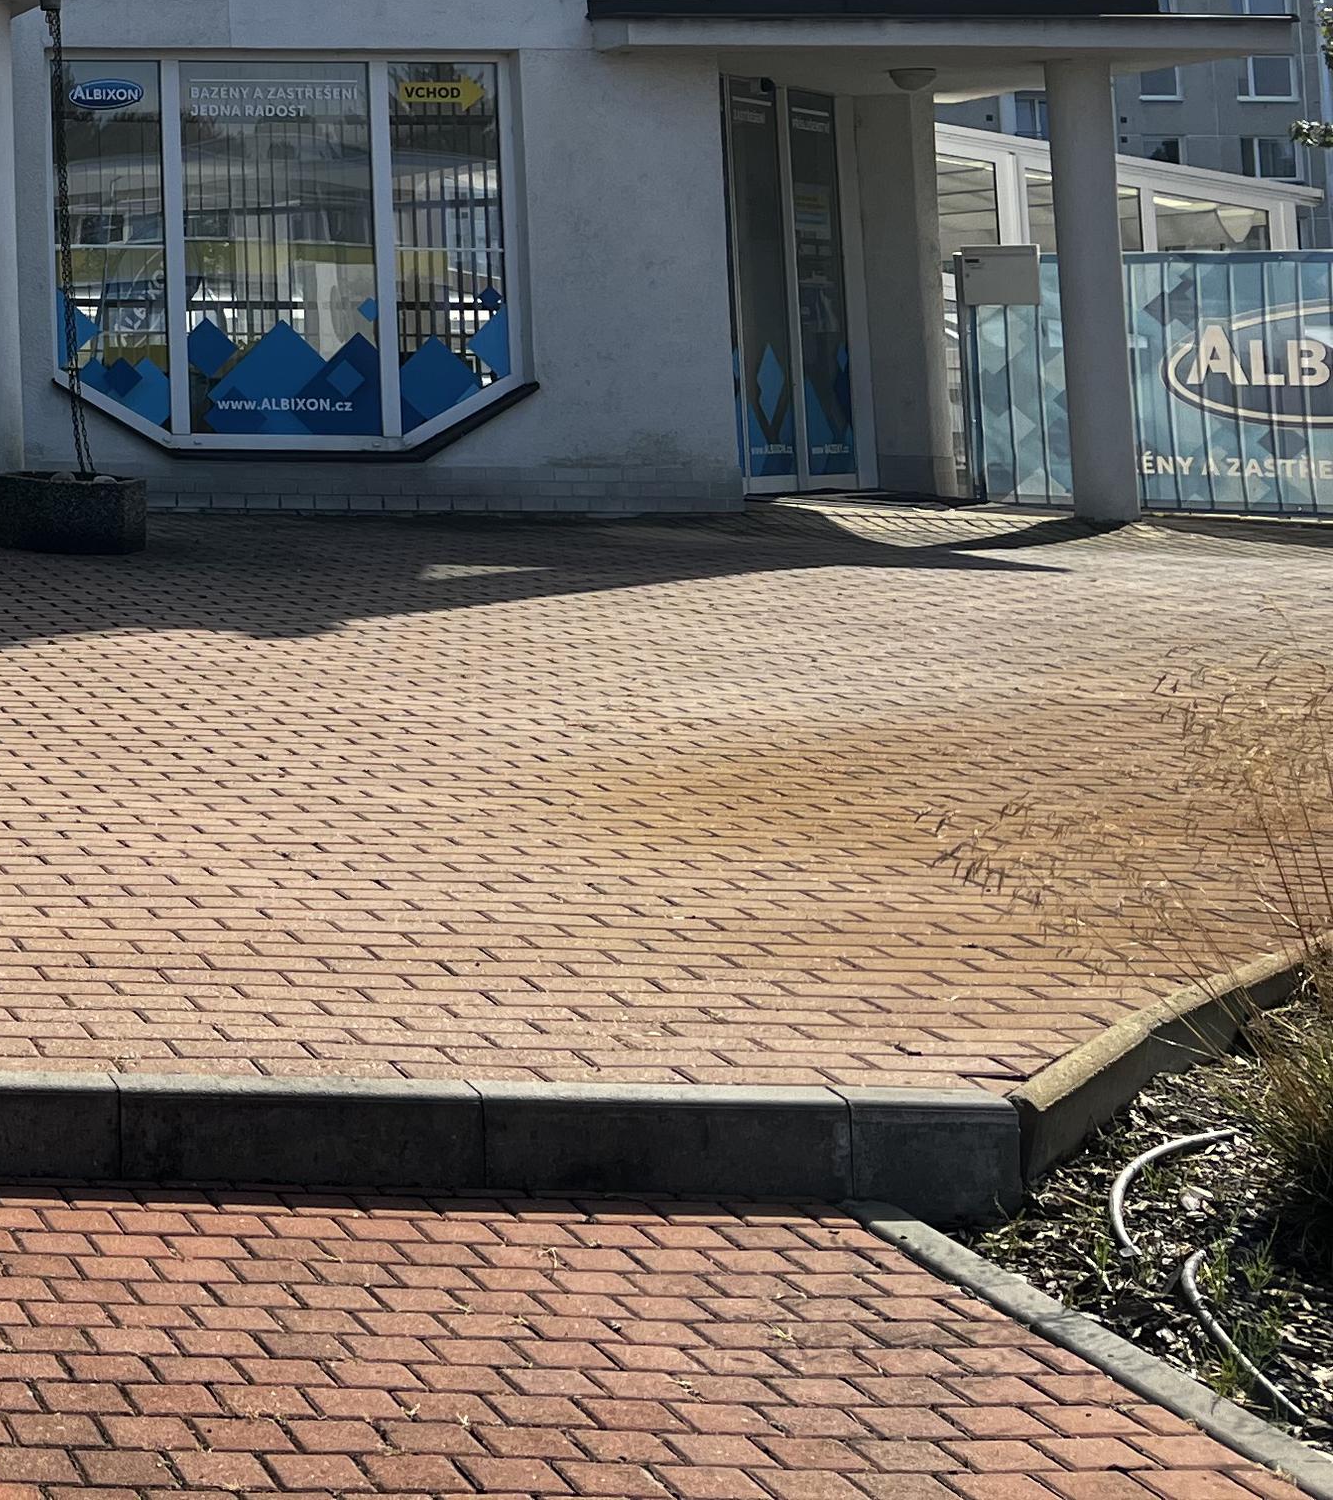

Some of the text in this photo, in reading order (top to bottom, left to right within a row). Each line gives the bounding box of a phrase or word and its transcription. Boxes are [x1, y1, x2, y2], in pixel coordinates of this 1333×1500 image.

[73, 85, 139, 100] ALBIXON
[190, 85, 358, 101] BAZÉNY A ZASTŘEŠENÍ
[406, 86, 461, 100] VCHOD
[190, 104, 306, 117] JEDNA RADOST
[1186, 325, 1333, 386] ALB
[217, 398, 353, 412] www.ALBIXON.cz
[1136, 451, 1333, 481] ÉNY A ZASTŘE
